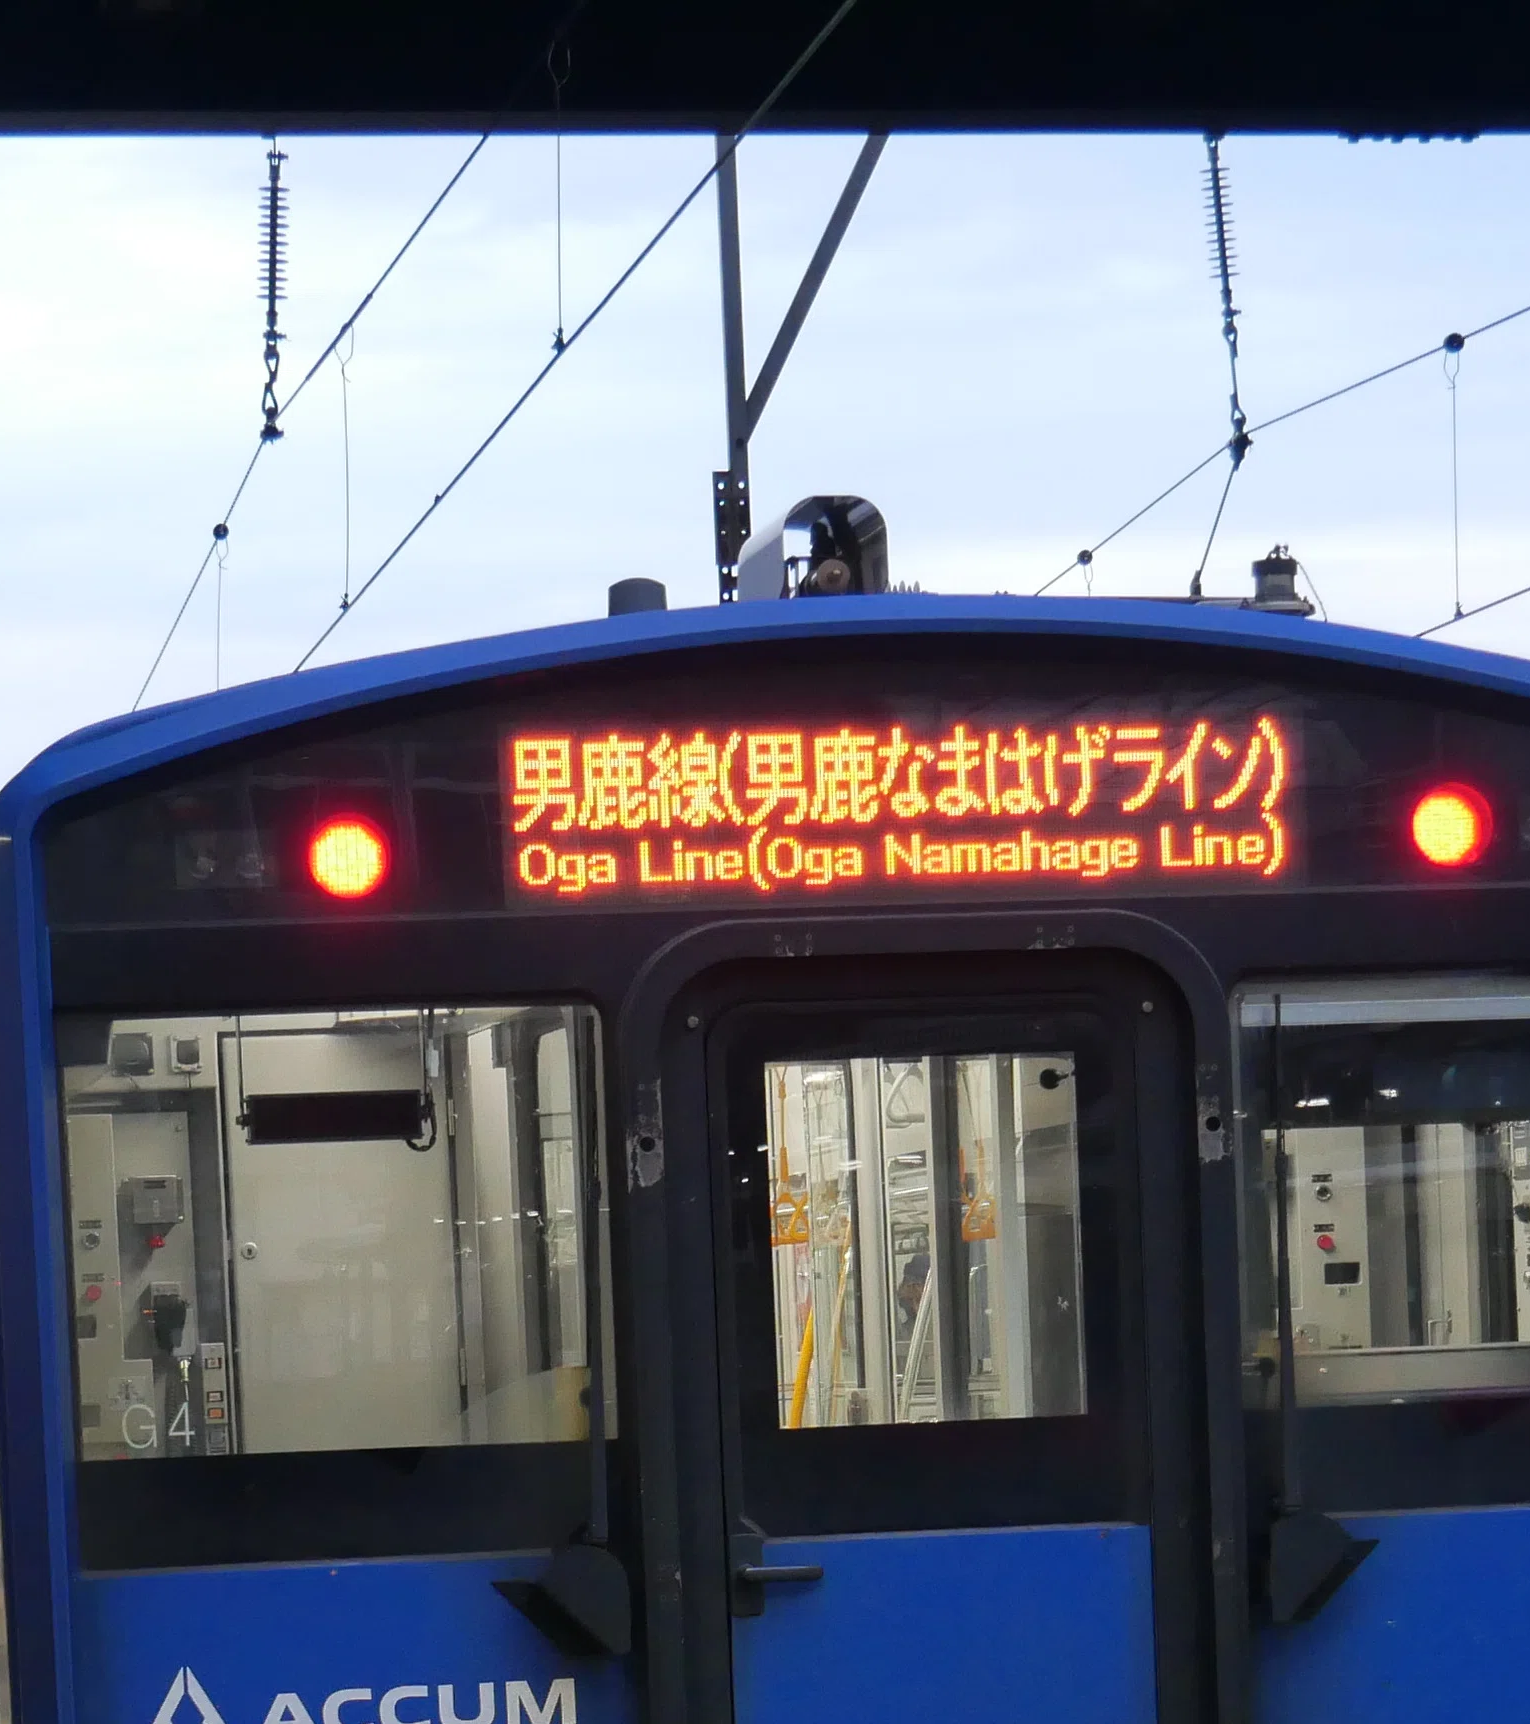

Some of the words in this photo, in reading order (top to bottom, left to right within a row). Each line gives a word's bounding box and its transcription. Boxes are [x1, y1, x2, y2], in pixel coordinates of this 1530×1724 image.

[512, 716, 1286, 832] 男鹿線(男鹿なまはげライン)
[517, 842, 618, 893] Oga
[884, 831, 1140, 878] Namahage
[1160, 811, 1286, 877] Line)
[122, 1402, 195, 1448] G4
